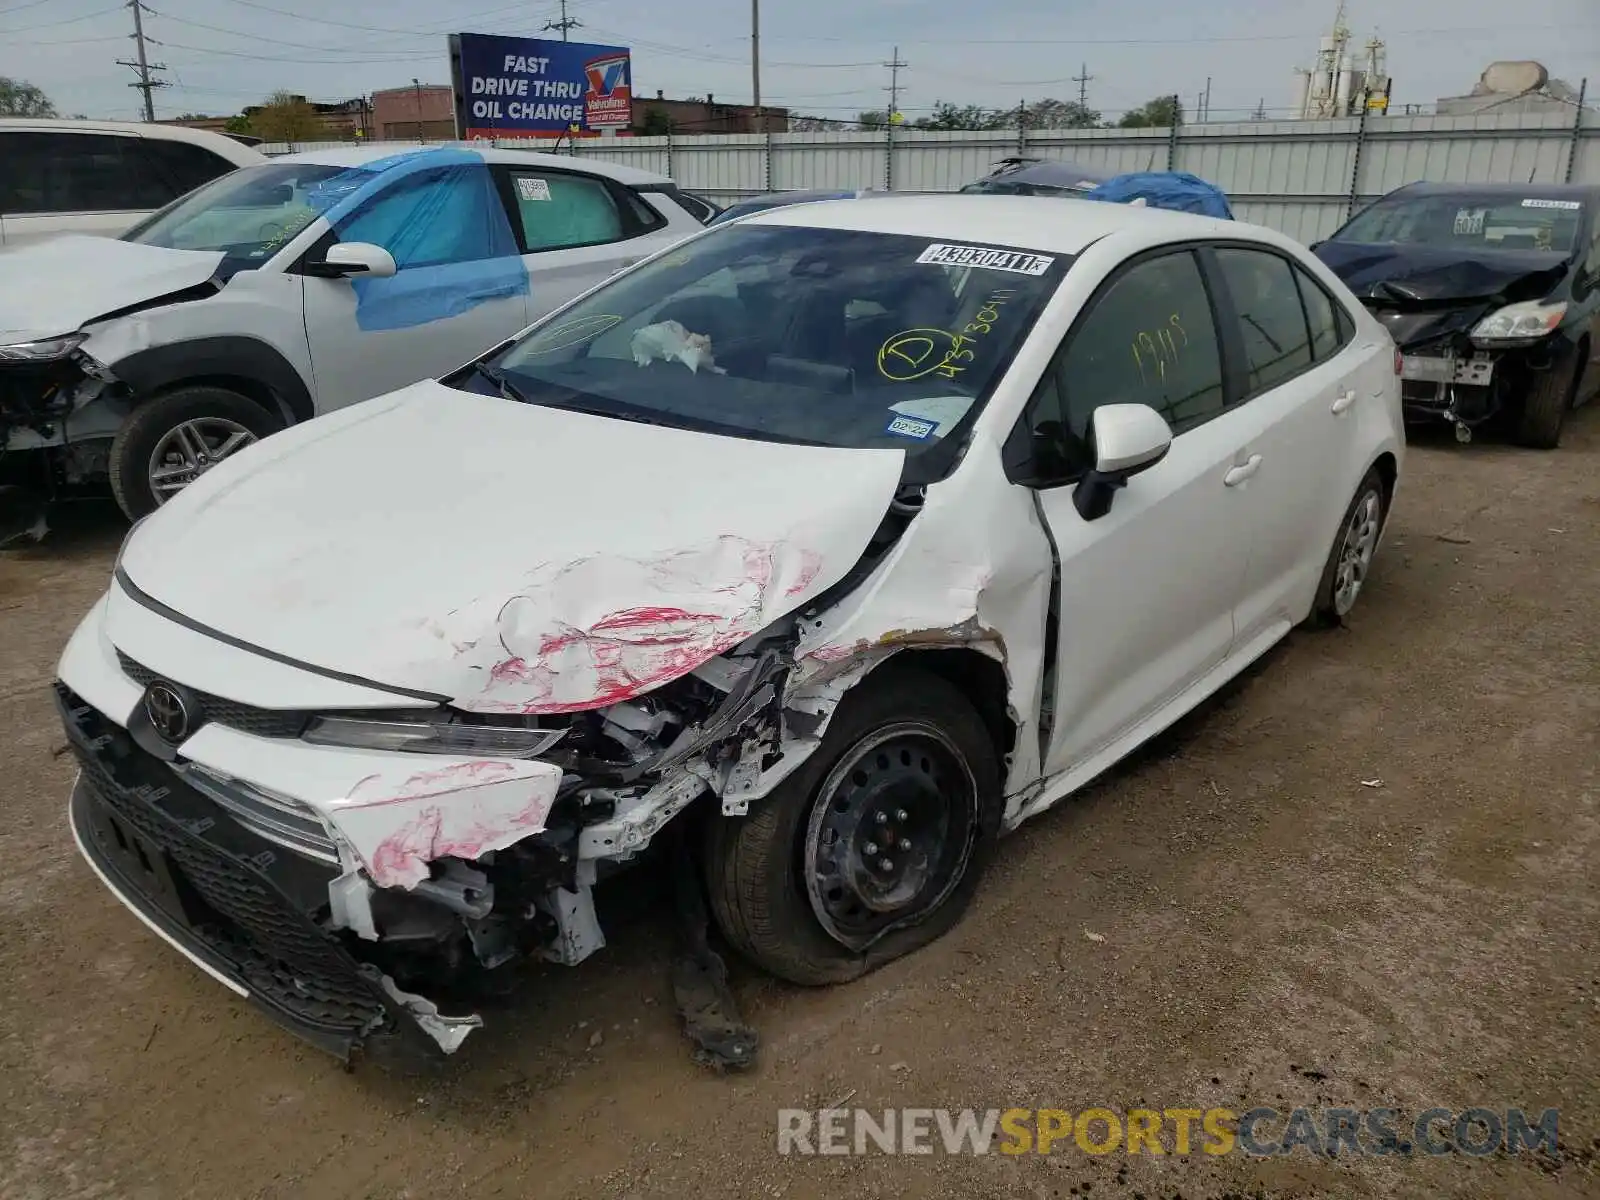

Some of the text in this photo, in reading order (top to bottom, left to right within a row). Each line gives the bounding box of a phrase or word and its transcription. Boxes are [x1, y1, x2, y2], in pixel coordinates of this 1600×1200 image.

[504, 55, 549, 74] FAST
[472, 77, 582, 98] DRIVE THRU
[473, 101, 584, 121] OIL CHANGE
[587, 98, 626, 111] Valvoline
[935, 245, 1035, 272] 43930411
